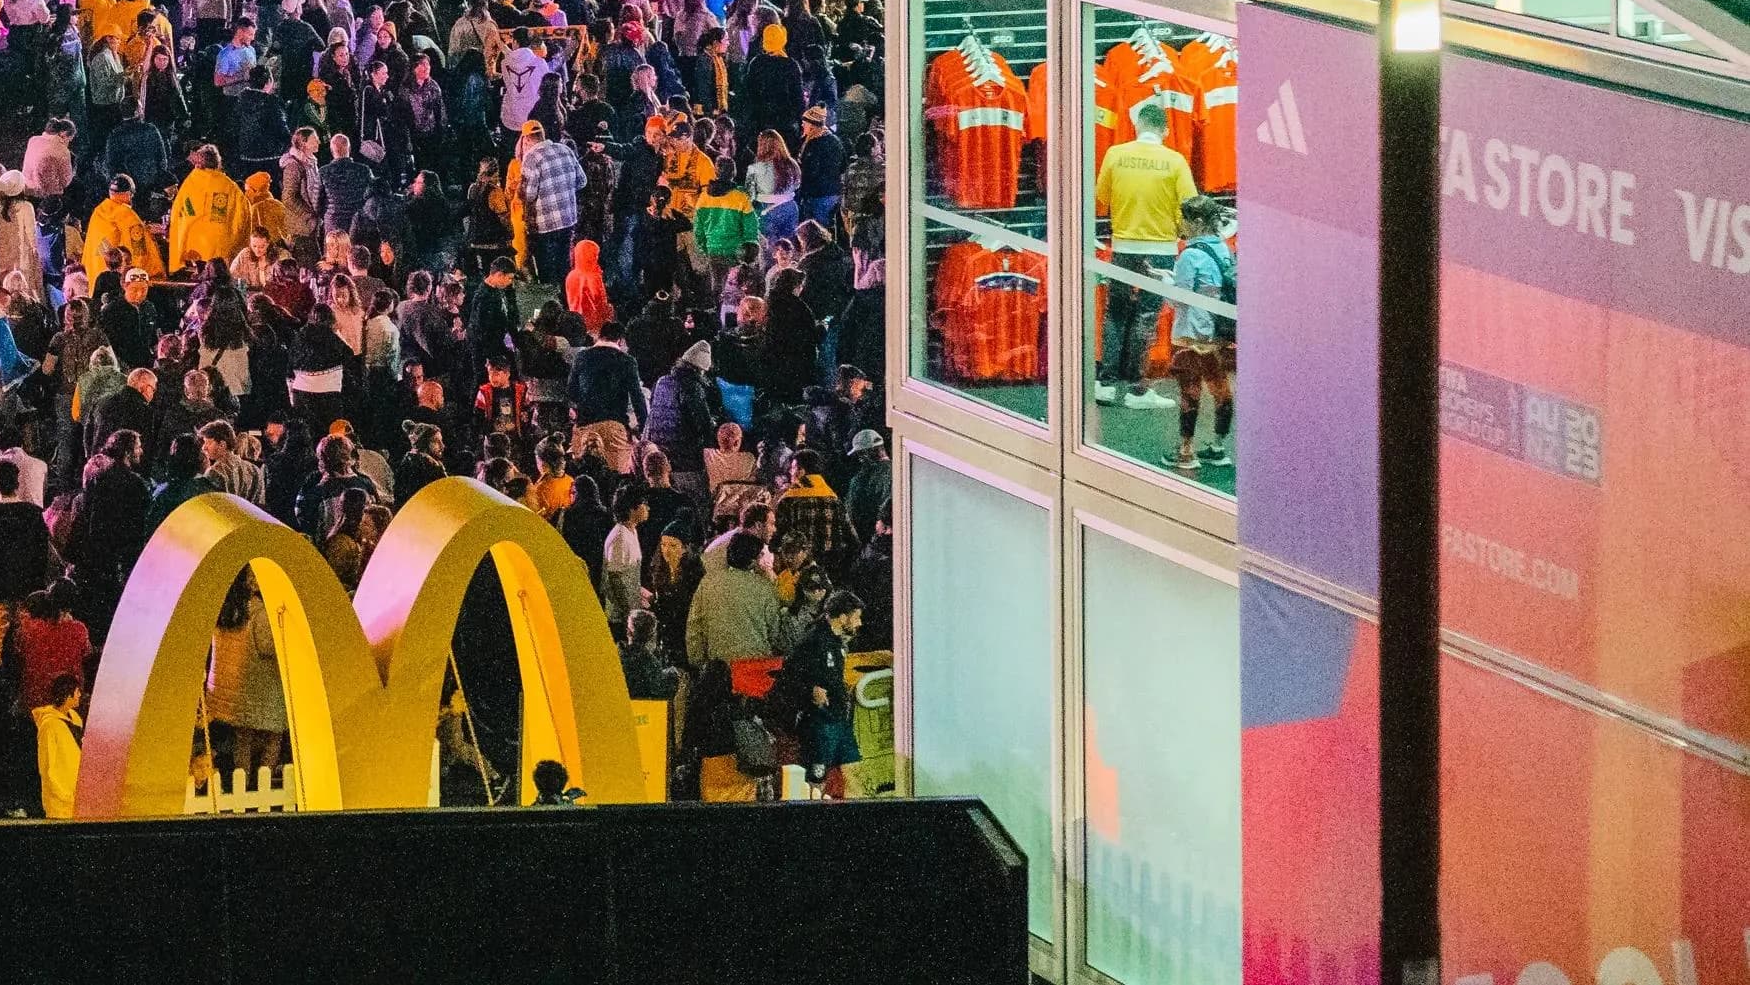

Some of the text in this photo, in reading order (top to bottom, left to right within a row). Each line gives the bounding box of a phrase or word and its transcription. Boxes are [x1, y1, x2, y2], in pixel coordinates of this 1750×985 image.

[1116, 155, 1171, 171] AUSTRALIA
[1482, 137, 1637, 246] STORE
[1565, 407, 1601, 447] 20
[1565, 442, 1602, 480] 23
